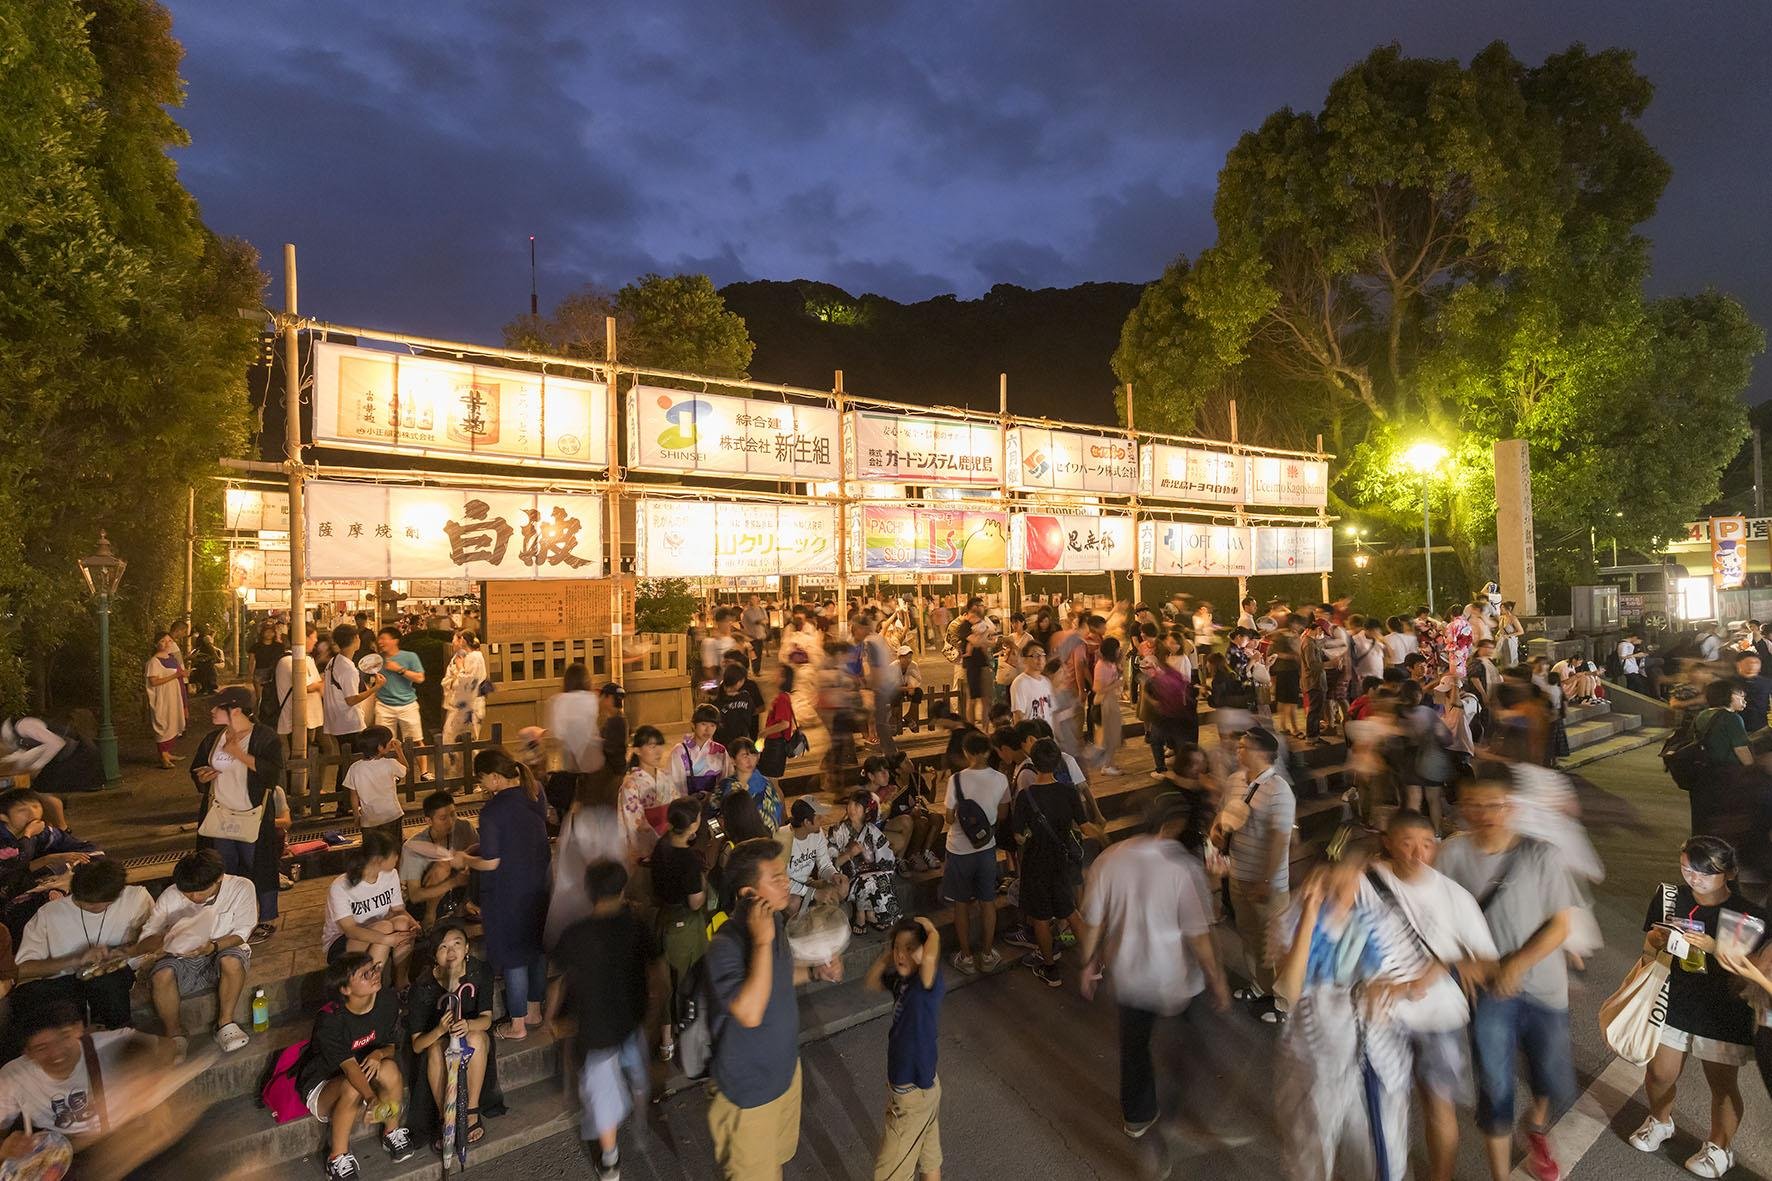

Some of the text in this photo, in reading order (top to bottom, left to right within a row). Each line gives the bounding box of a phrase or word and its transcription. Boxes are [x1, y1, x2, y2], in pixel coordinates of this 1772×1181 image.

[659, 449, 707, 462] SHINSEI
[719, 432, 832, 465] 株式会社 新生組
[443, 499, 597, 569] 白波
[1719, 521, 1739, 538] P
